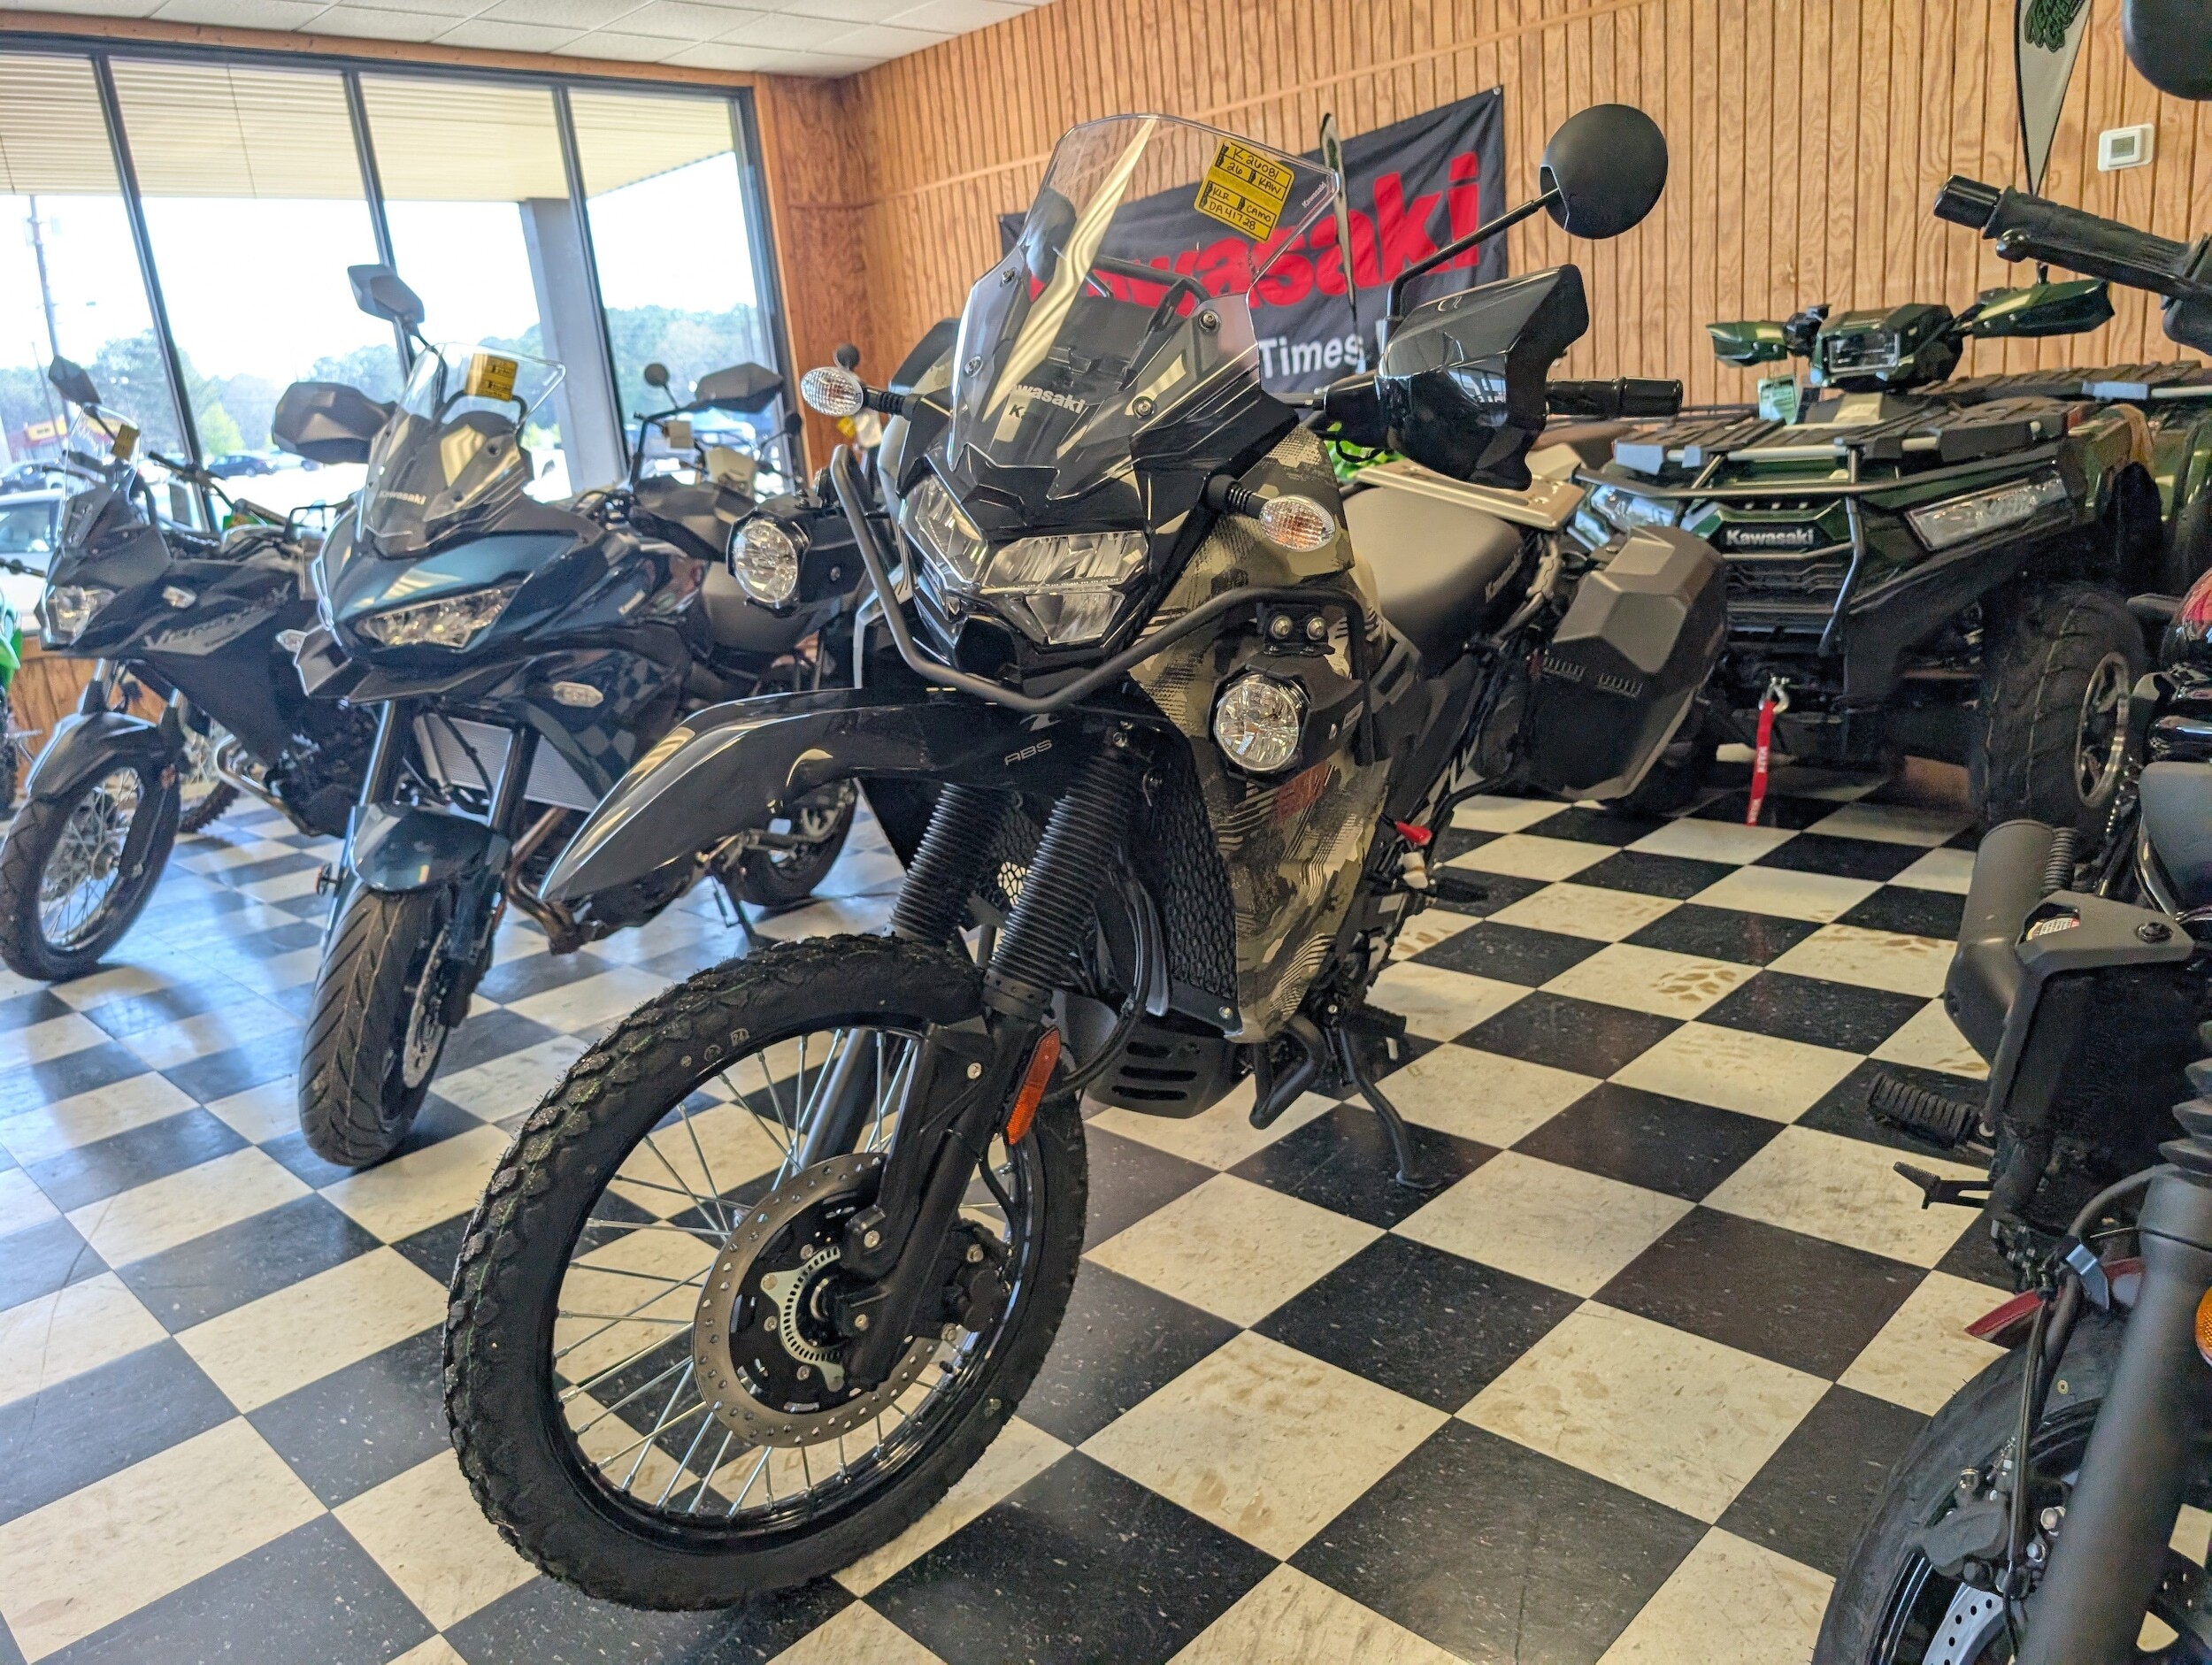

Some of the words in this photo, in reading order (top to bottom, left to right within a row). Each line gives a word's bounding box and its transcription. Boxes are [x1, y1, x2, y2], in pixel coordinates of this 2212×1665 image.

[1211, 187, 1230, 201] KLR
[1258, 176, 1282, 195] KAW
[1258, 333, 1364, 380] Times
[1725, 527, 1815, 547] Kawasaki
[1004, 739, 1053, 766] ABS
